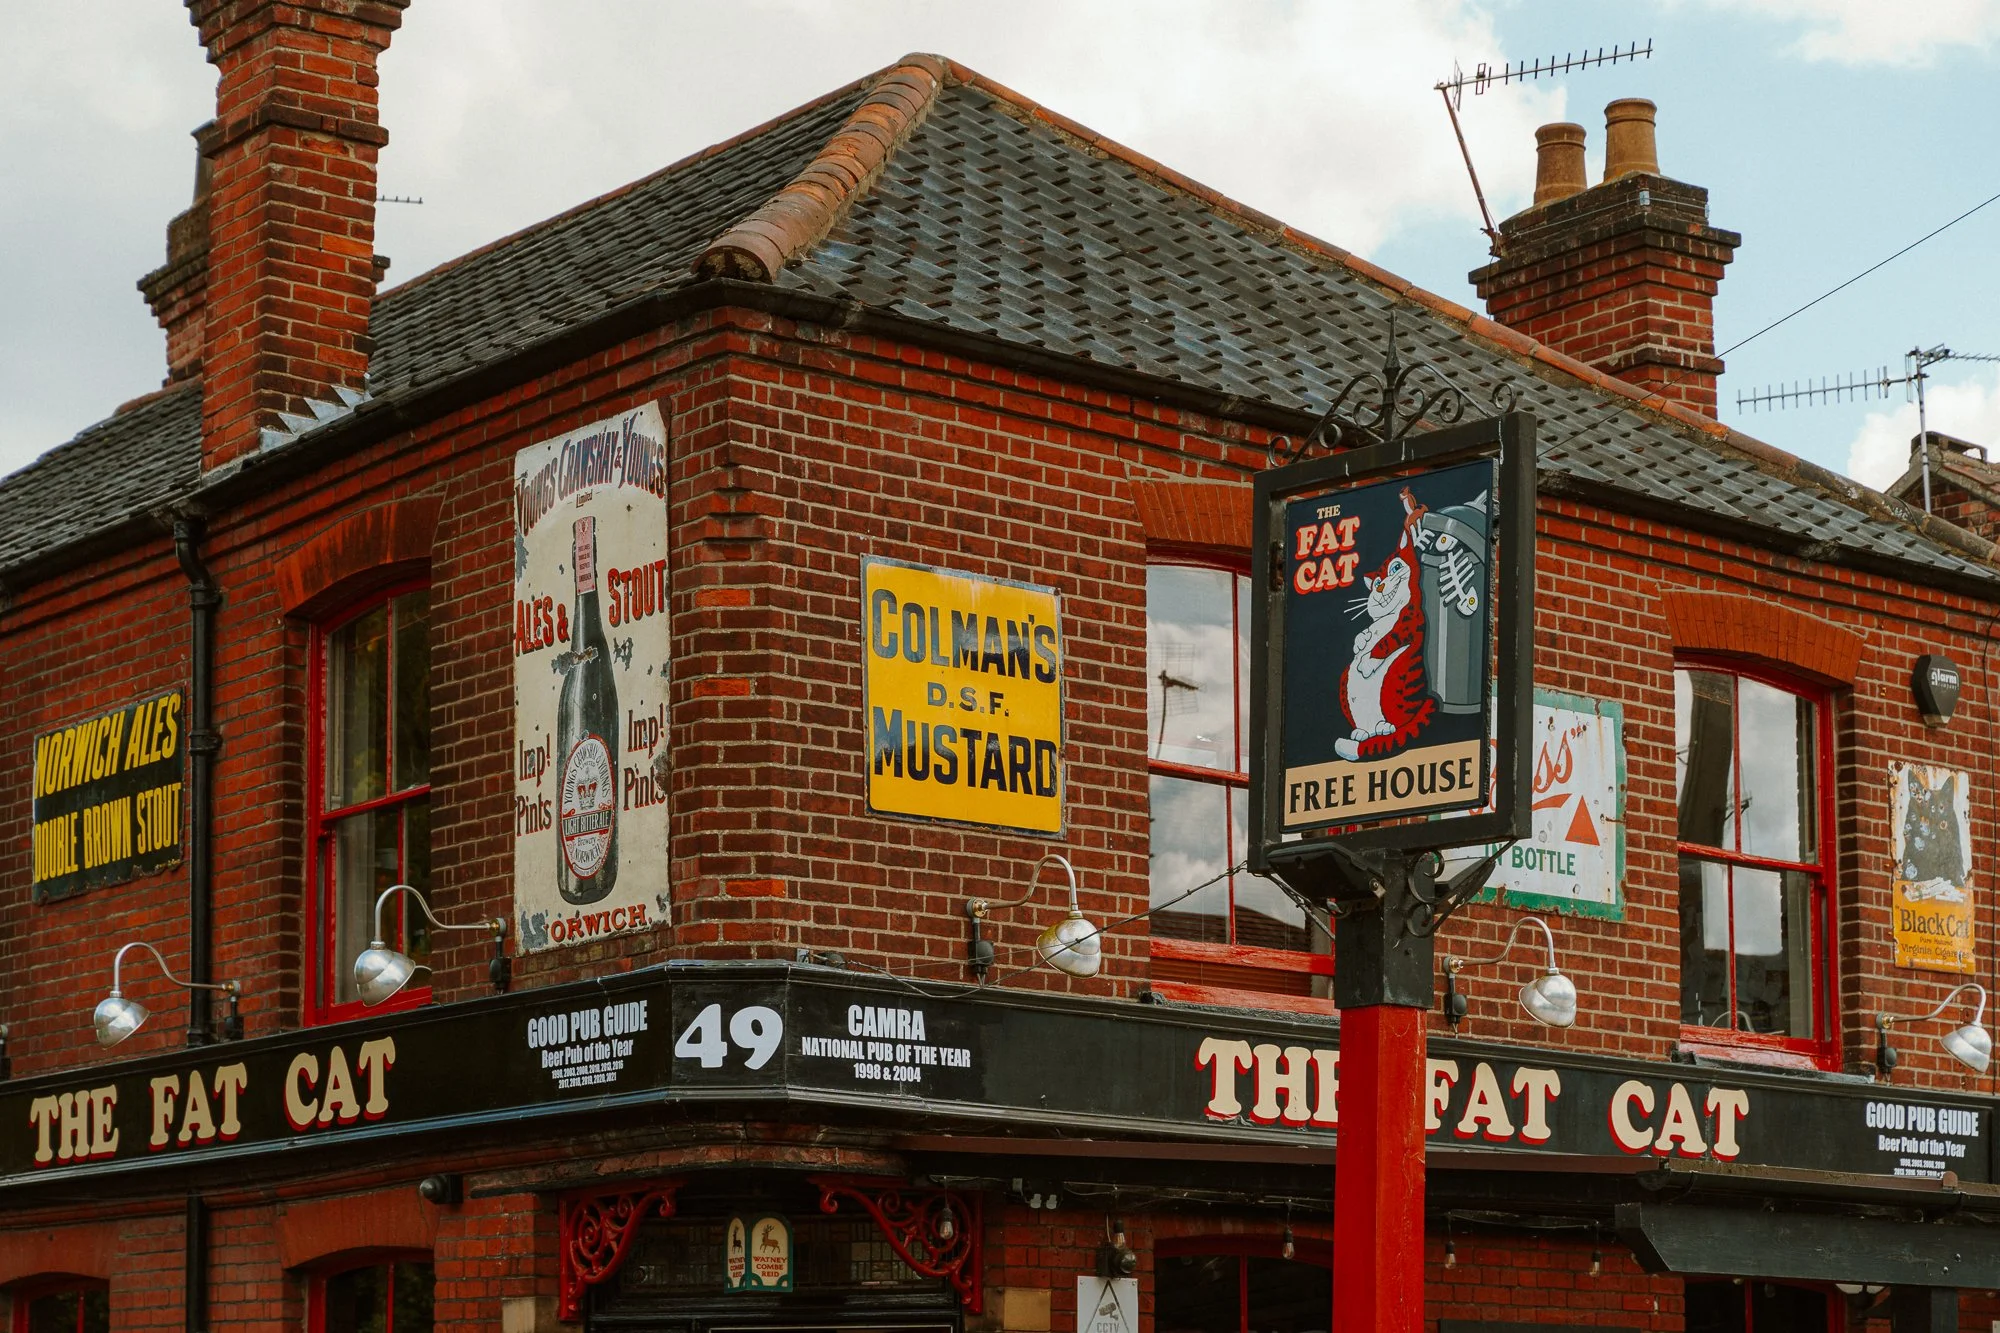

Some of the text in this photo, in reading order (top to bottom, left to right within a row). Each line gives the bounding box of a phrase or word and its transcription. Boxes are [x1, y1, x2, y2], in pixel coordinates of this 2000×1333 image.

[515, 411, 665, 537] YOUNGS CRAWSHAY & YOUNGS
[1317, 504, 1341, 520] THE
[1295, 515, 1360, 560] FAT
[1293, 552, 1360, 595] CAT
[516, 559, 667, 657] ALES & STOUT
[872, 589, 1057, 684] COLMAN'S
[927, 682, 1010, 717] D.S.F.
[34, 692, 181, 799] NORWICH ALES
[628, 703, 665, 758] Imp!
[872, 706, 1058, 798] MUSTARD
[519, 733, 551, 788] Imp!
[564, 768, 578, 805] YOUNGS
[1289, 757, 1474, 814] FREE HOUSE
[34, 782, 181, 883] DOUBLE BROWN STOUT
[516, 793, 552, 837] Pints
[565, 810, 609, 835] LIGHT BITTER ALE
[1511, 846, 1576, 876] BOTTLE
[545, 903, 653, 943] ORWICH.
[528, 1000, 648, 1049] GOOD PUB GUIDE
[674, 1003, 783, 1070] 49
[848, 1004, 926, 1041] CAMRA
[542, 1039, 633, 1069] Beer Pub of the Year
[802, 1036, 971, 1067] NATIONAL PUB OF THE YEAR
[853, 1062, 921, 1082] 1998 & 2004
[30, 1035, 396, 1169] THE FAT CAT
[1195, 1037, 1750, 1162] THE FAT CAT
[1866, 1101, 1979, 1137] GOOD PUB GUIDE
[1878, 1134, 1966, 1158] Beer Pub of the Year
[1096, 1323, 1120, 1333] CCTV
